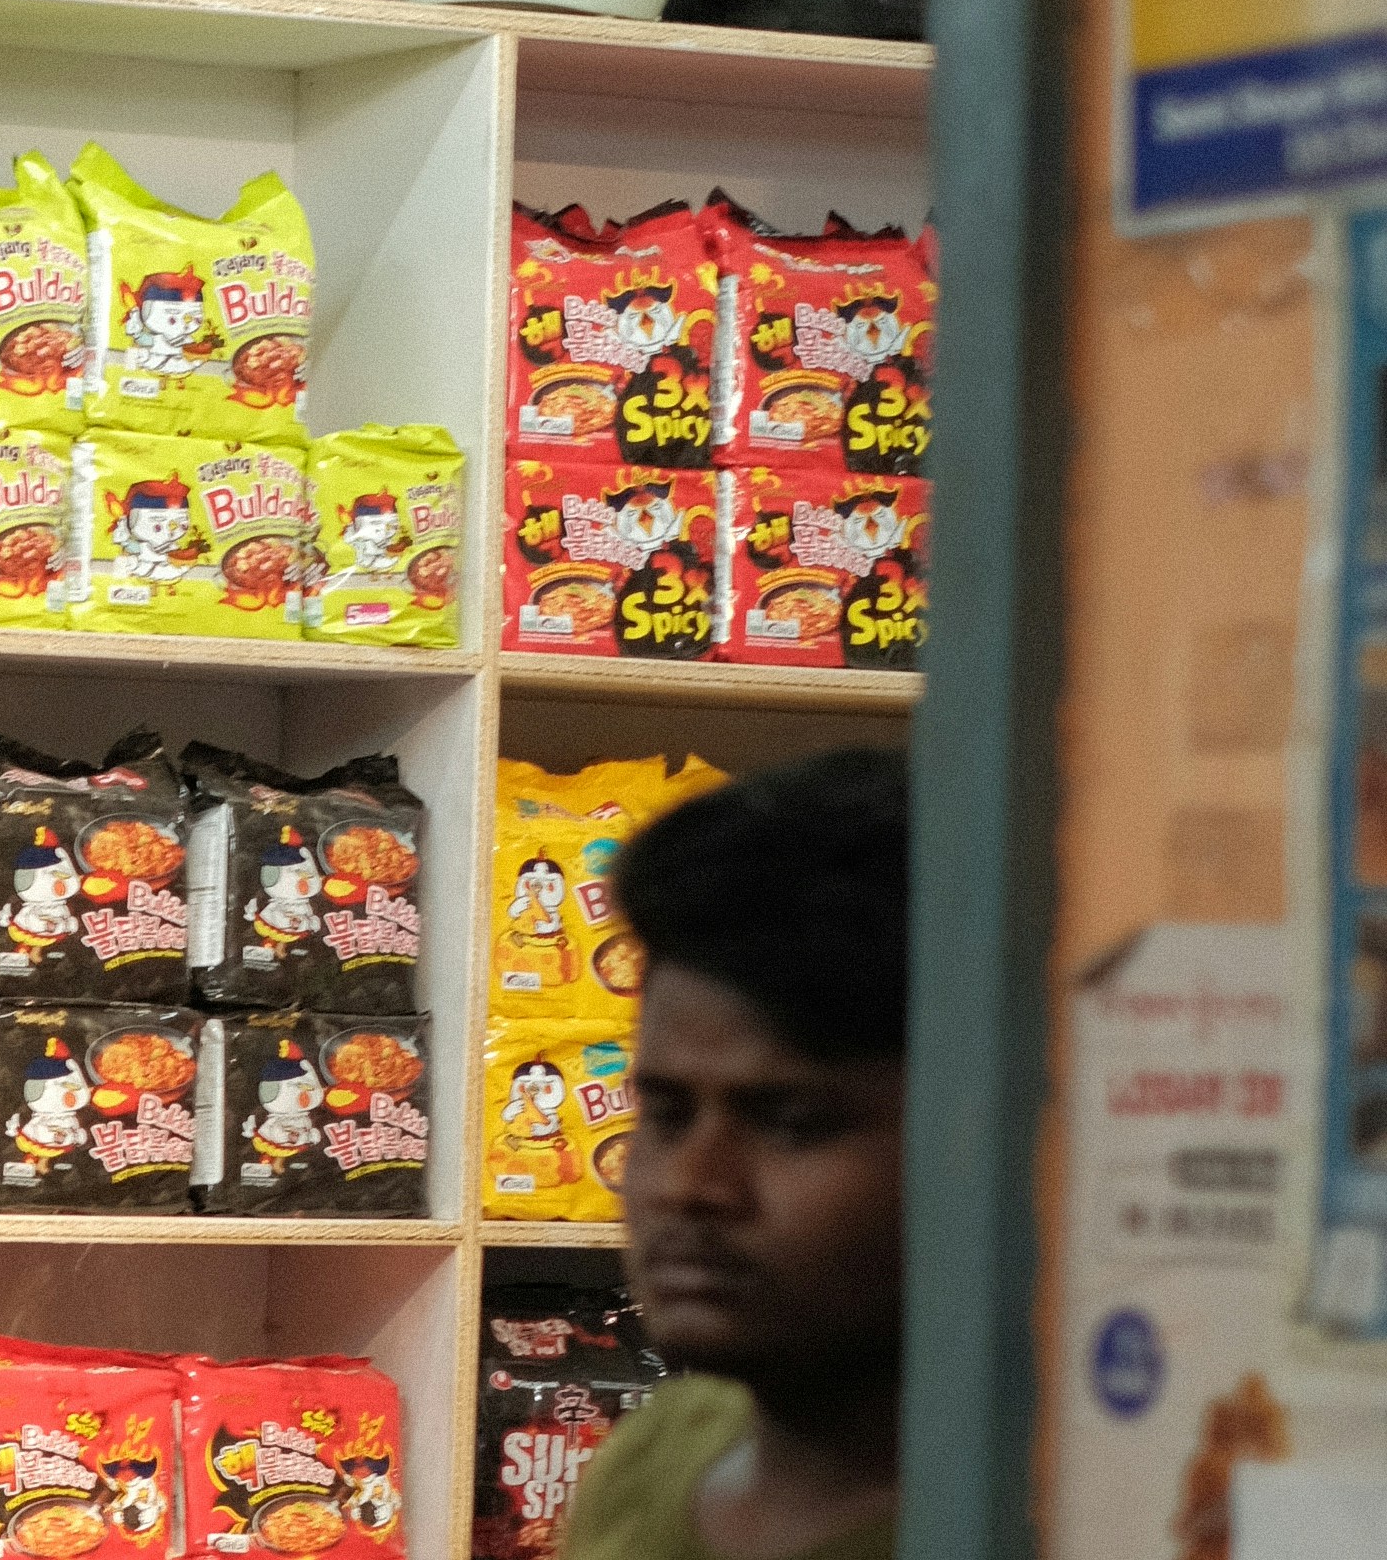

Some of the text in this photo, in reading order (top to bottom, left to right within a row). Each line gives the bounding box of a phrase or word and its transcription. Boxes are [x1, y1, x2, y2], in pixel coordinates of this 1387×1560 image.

[651, 356, 711, 411] 3x
[623, 393, 712, 447] Spicy
[651, 552, 708, 606] 3x
[622, 591, 710, 644] Spicy
